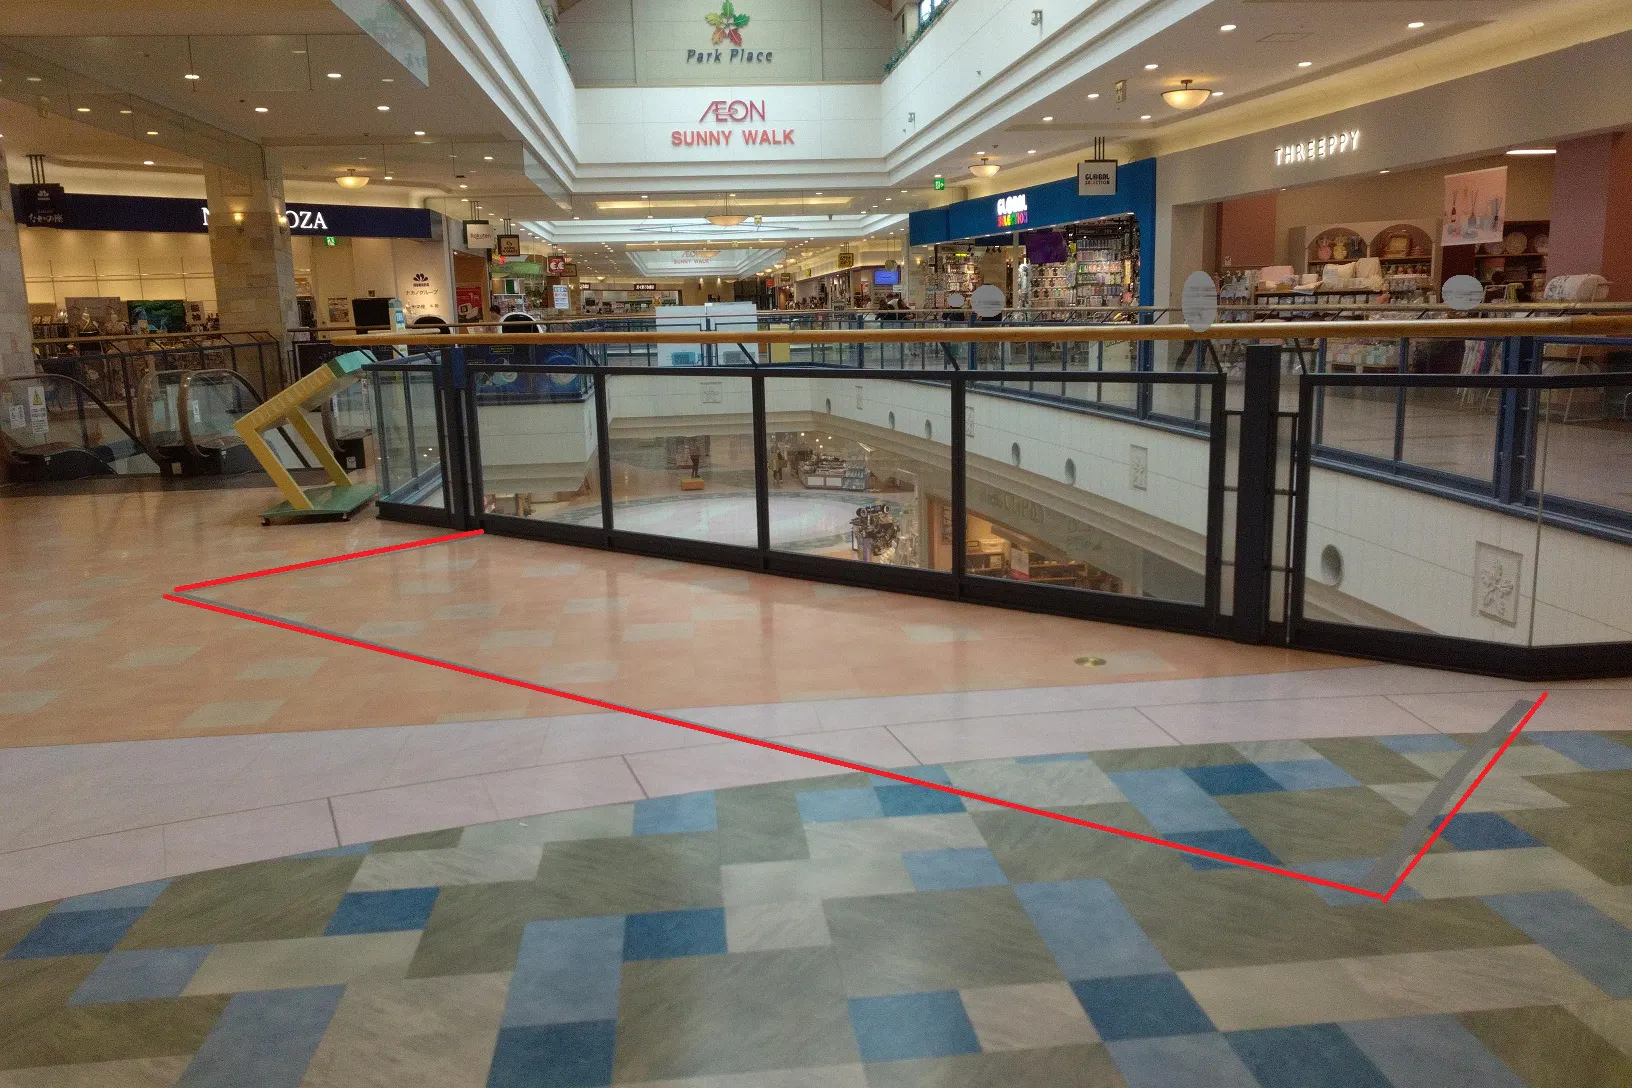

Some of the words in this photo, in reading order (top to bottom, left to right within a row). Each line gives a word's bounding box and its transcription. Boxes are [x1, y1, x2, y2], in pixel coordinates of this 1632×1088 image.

[687, 48, 722, 63] Park
[729, 48, 773, 63] Place
[671, 130, 732, 146] SUNNY
[742, 129, 795, 145] WALK
[1273, 130, 1360, 166] THREEPPY
[1084, 173, 1110, 181] GLOBAL
[997, 194, 1028, 215] GLOBAL
